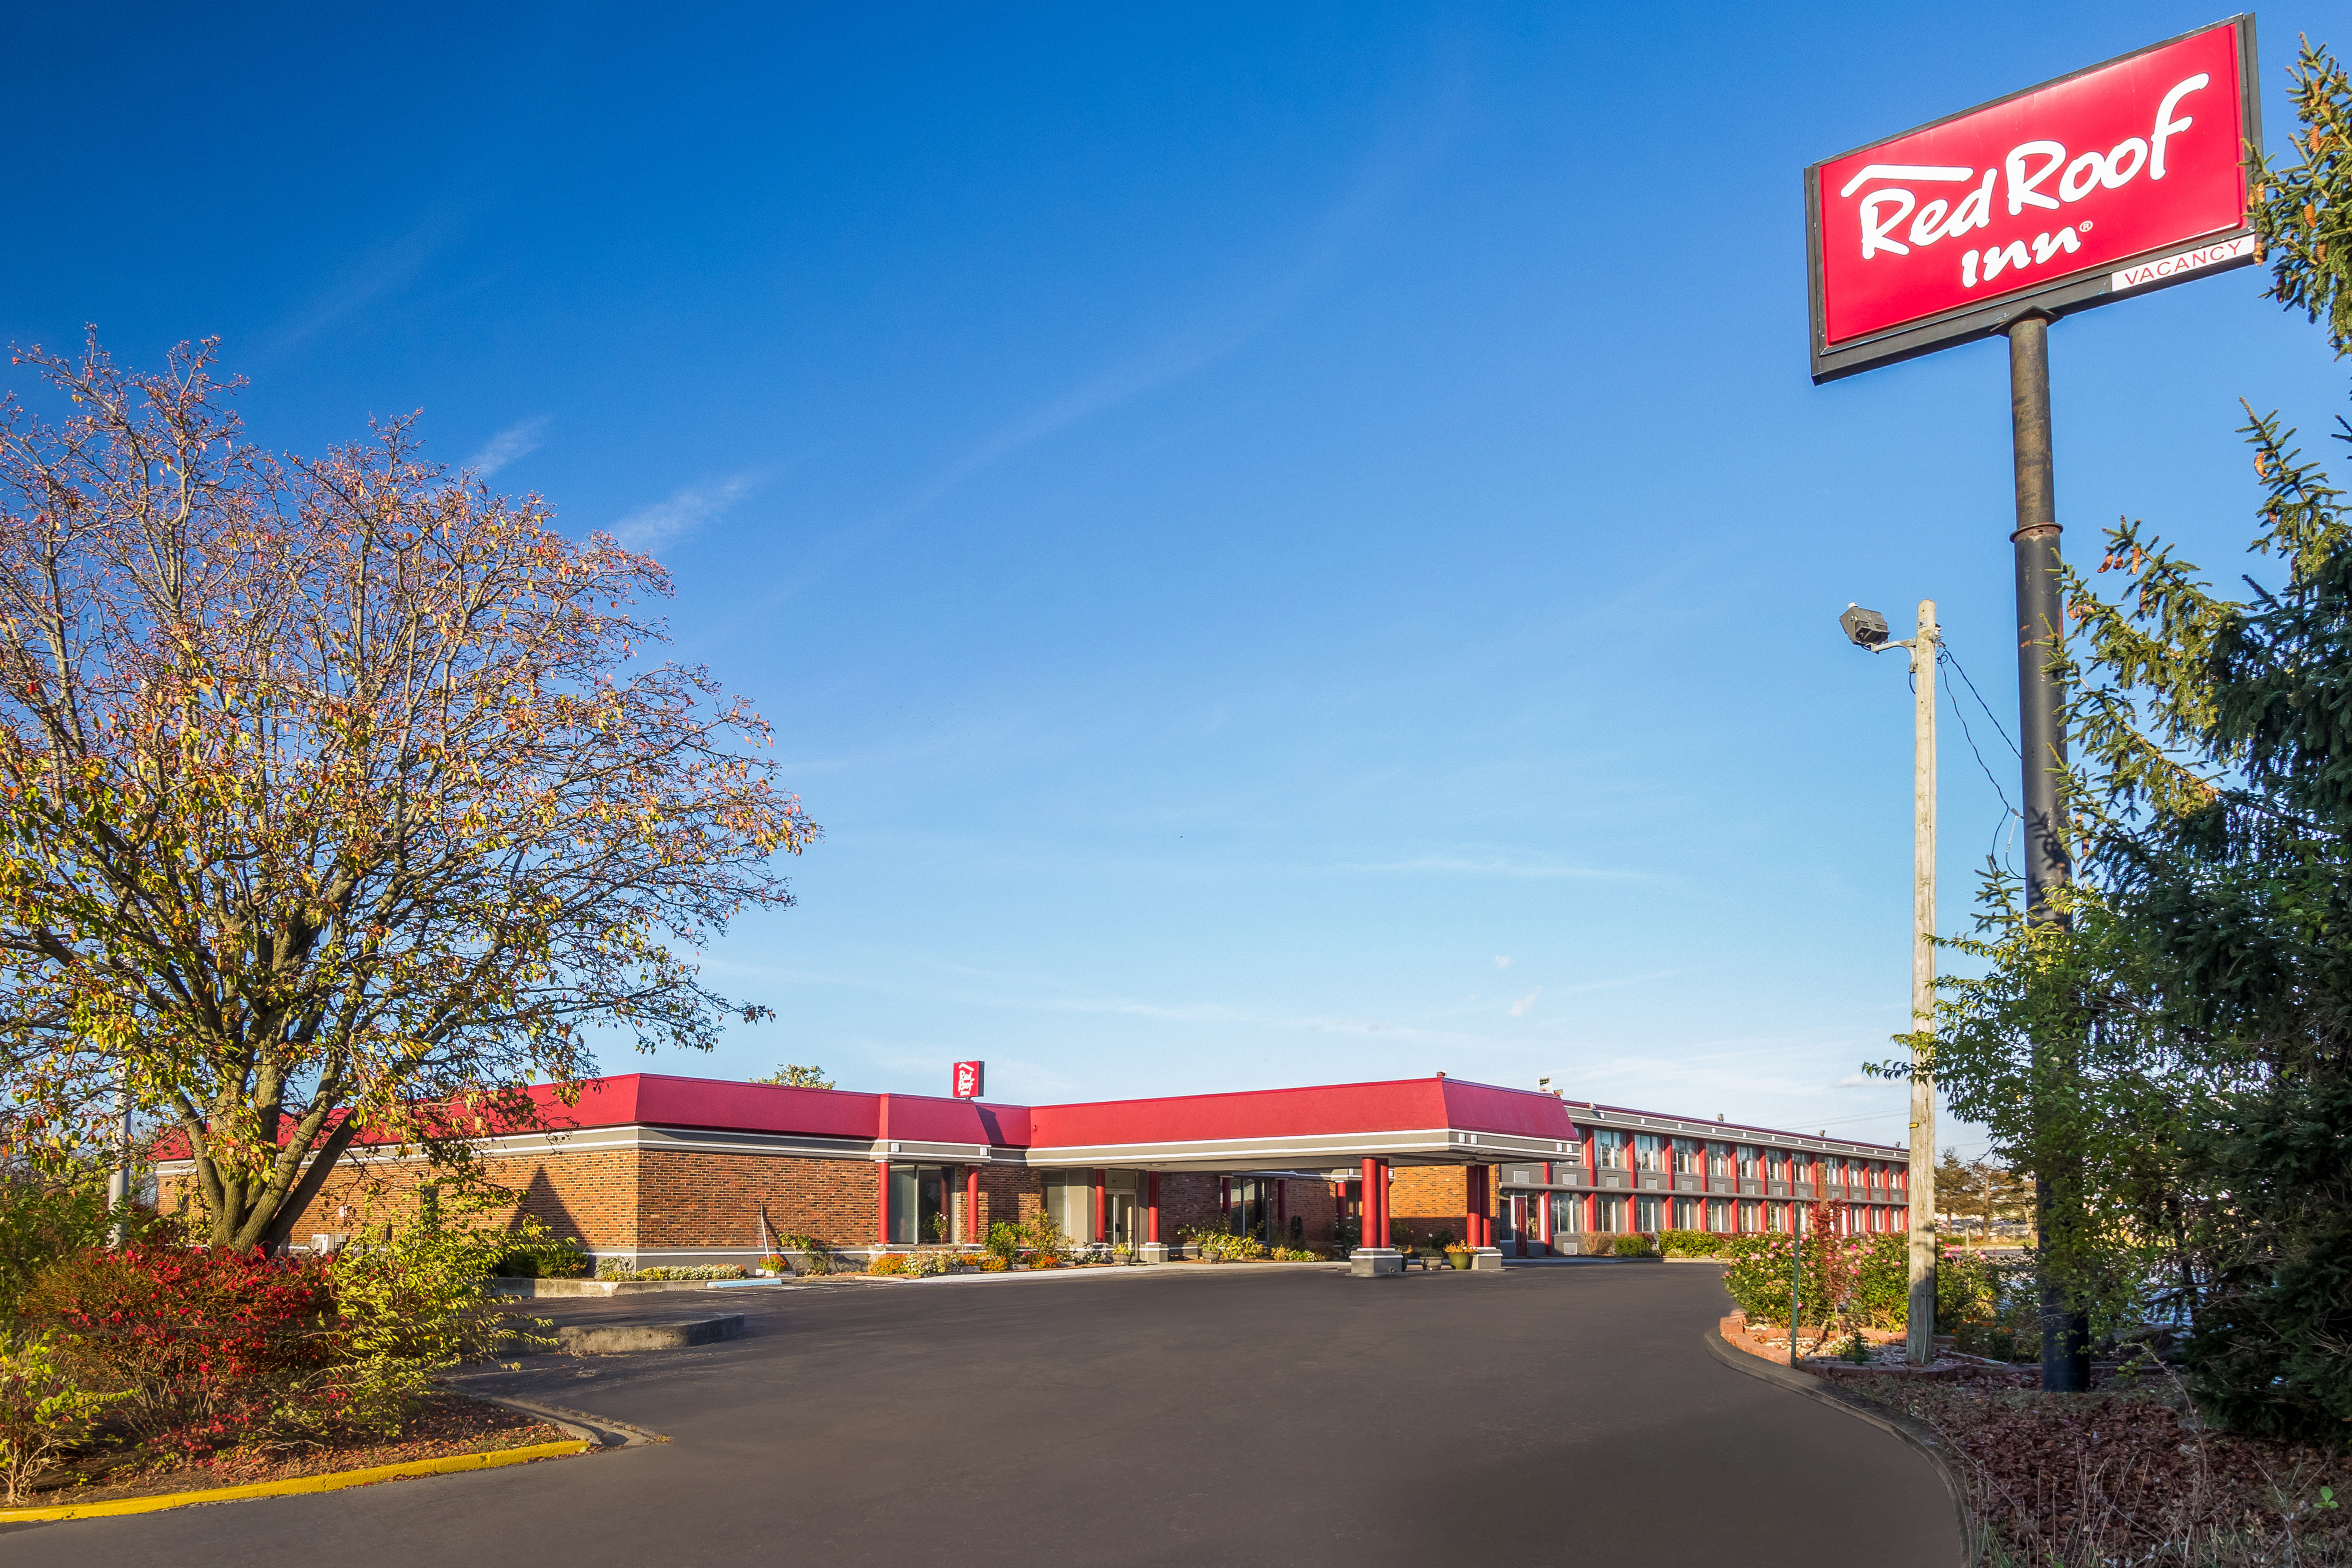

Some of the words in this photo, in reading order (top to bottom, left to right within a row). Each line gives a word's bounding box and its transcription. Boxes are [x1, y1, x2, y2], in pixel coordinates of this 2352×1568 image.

[1858, 168, 1998, 260] Red
[2005, 73, 2209, 216] Roof
[2124, 240, 2241, 285] VACANCY
[958, 1078, 975, 1092] Roof
